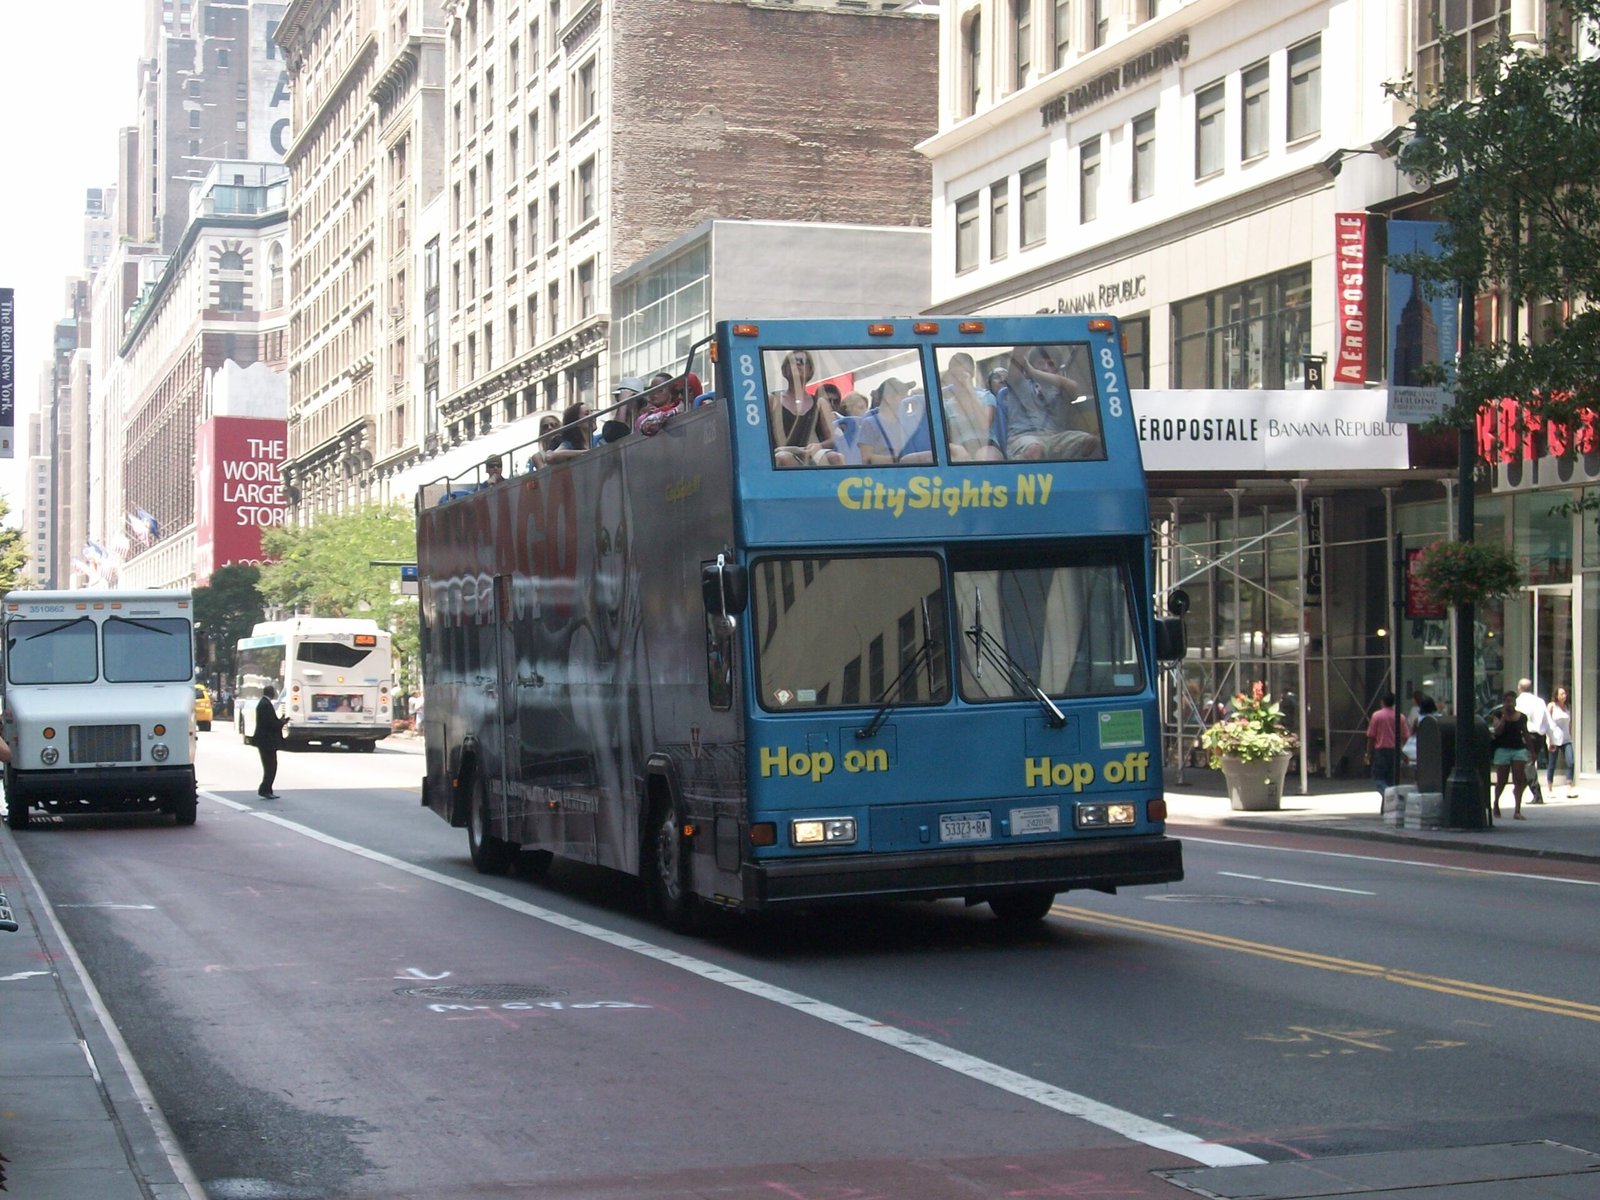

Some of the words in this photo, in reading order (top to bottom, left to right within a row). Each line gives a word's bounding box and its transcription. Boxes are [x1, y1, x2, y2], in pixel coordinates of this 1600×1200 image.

[1058, 292, 1097, 314] BANANA
[1099, 274, 1146, 309] REPUBLIC
[1, 301, 13, 324] The
[1, 325, 13, 353] Real
[1, 354, 13, 381] New
[1100, 348, 1122, 417] 828
[1, 383, 13, 415] York.
[740, 354, 760, 426] 828
[1140, 415, 1258, 441] ÉROPOSTALE
[1269, 419, 1331, 437] BANANA
[1335, 418, 1402, 437] REPUBLIC
[247, 439, 284, 460] THE
[1016, 473, 1053, 505] NY
[760, 746, 834, 782] Hop
[844, 748, 888, 773] on
[1025, 756, 1095, 793] Hop
[1103, 751, 1149, 784] off
